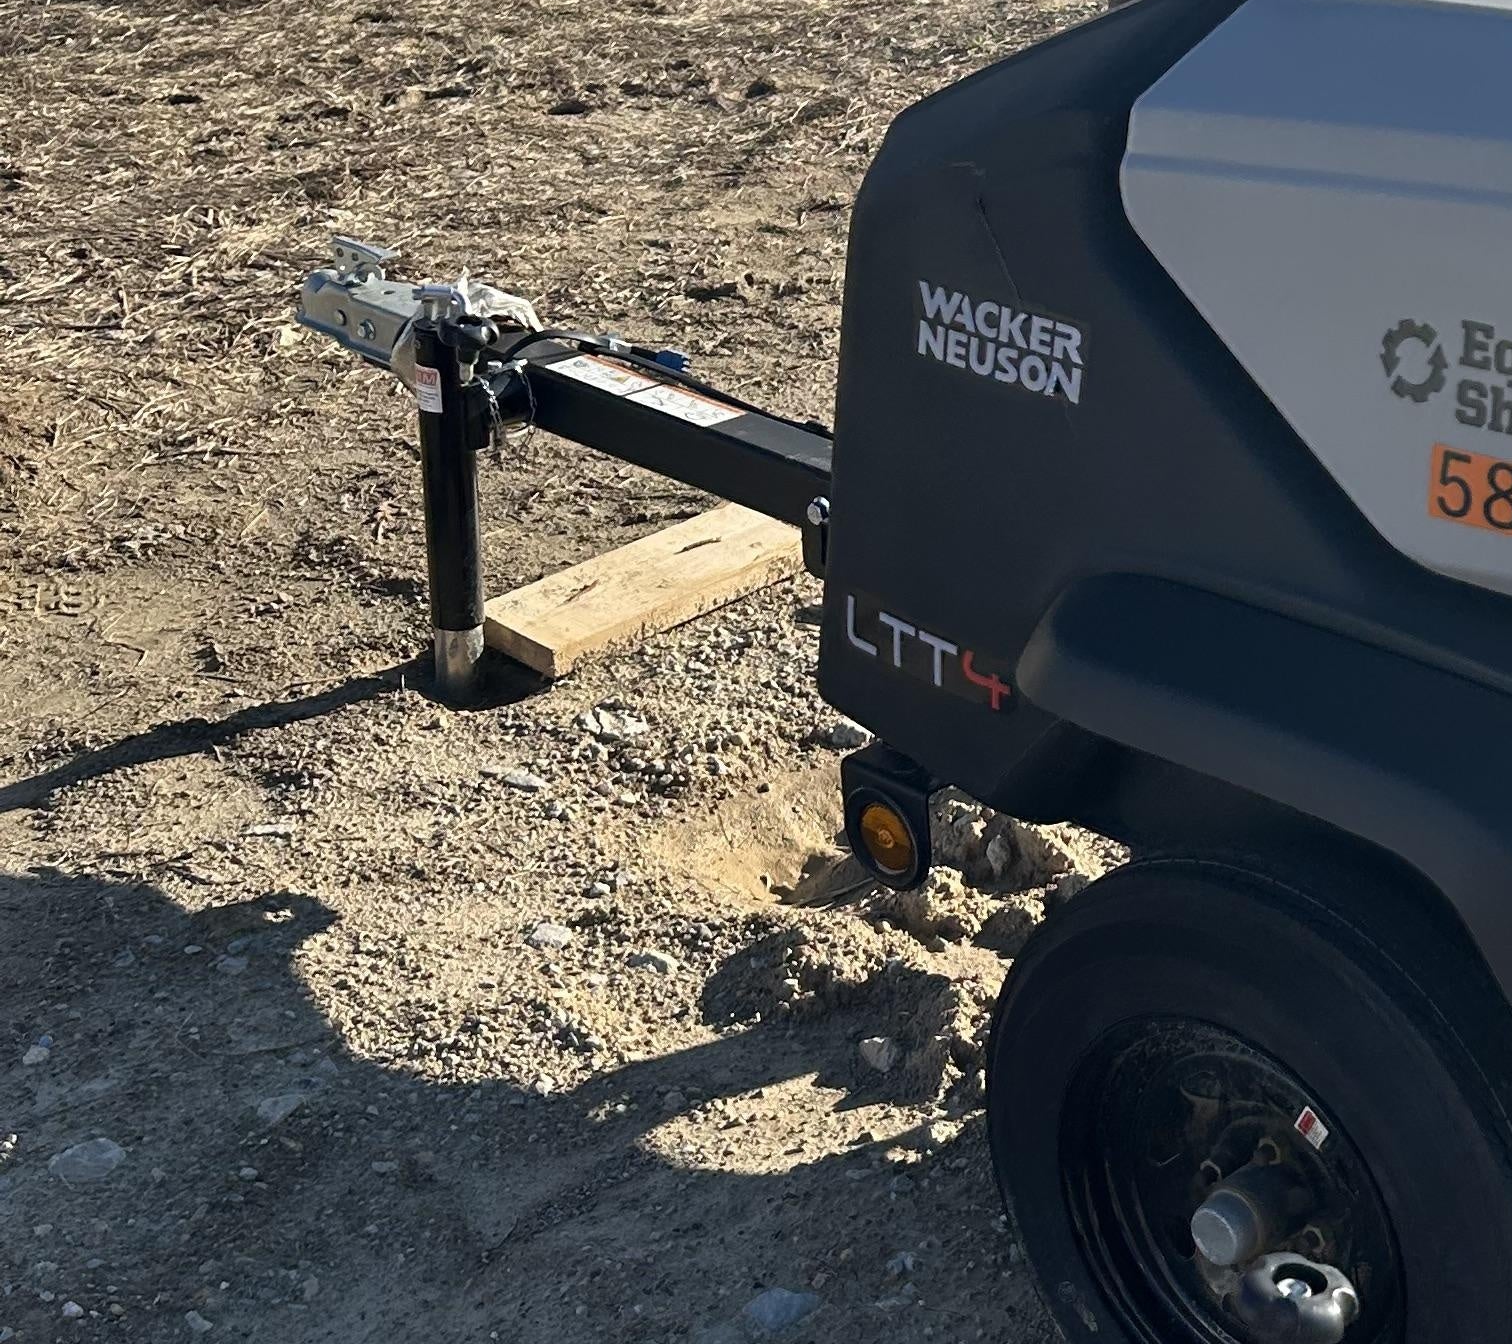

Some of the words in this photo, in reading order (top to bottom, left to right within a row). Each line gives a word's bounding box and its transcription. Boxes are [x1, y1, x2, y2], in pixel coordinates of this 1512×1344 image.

[918, 319, 1082, 404] NEUSON
[919, 280, 1083, 365] WACKER
[847, 594, 1011, 710] LTT4
